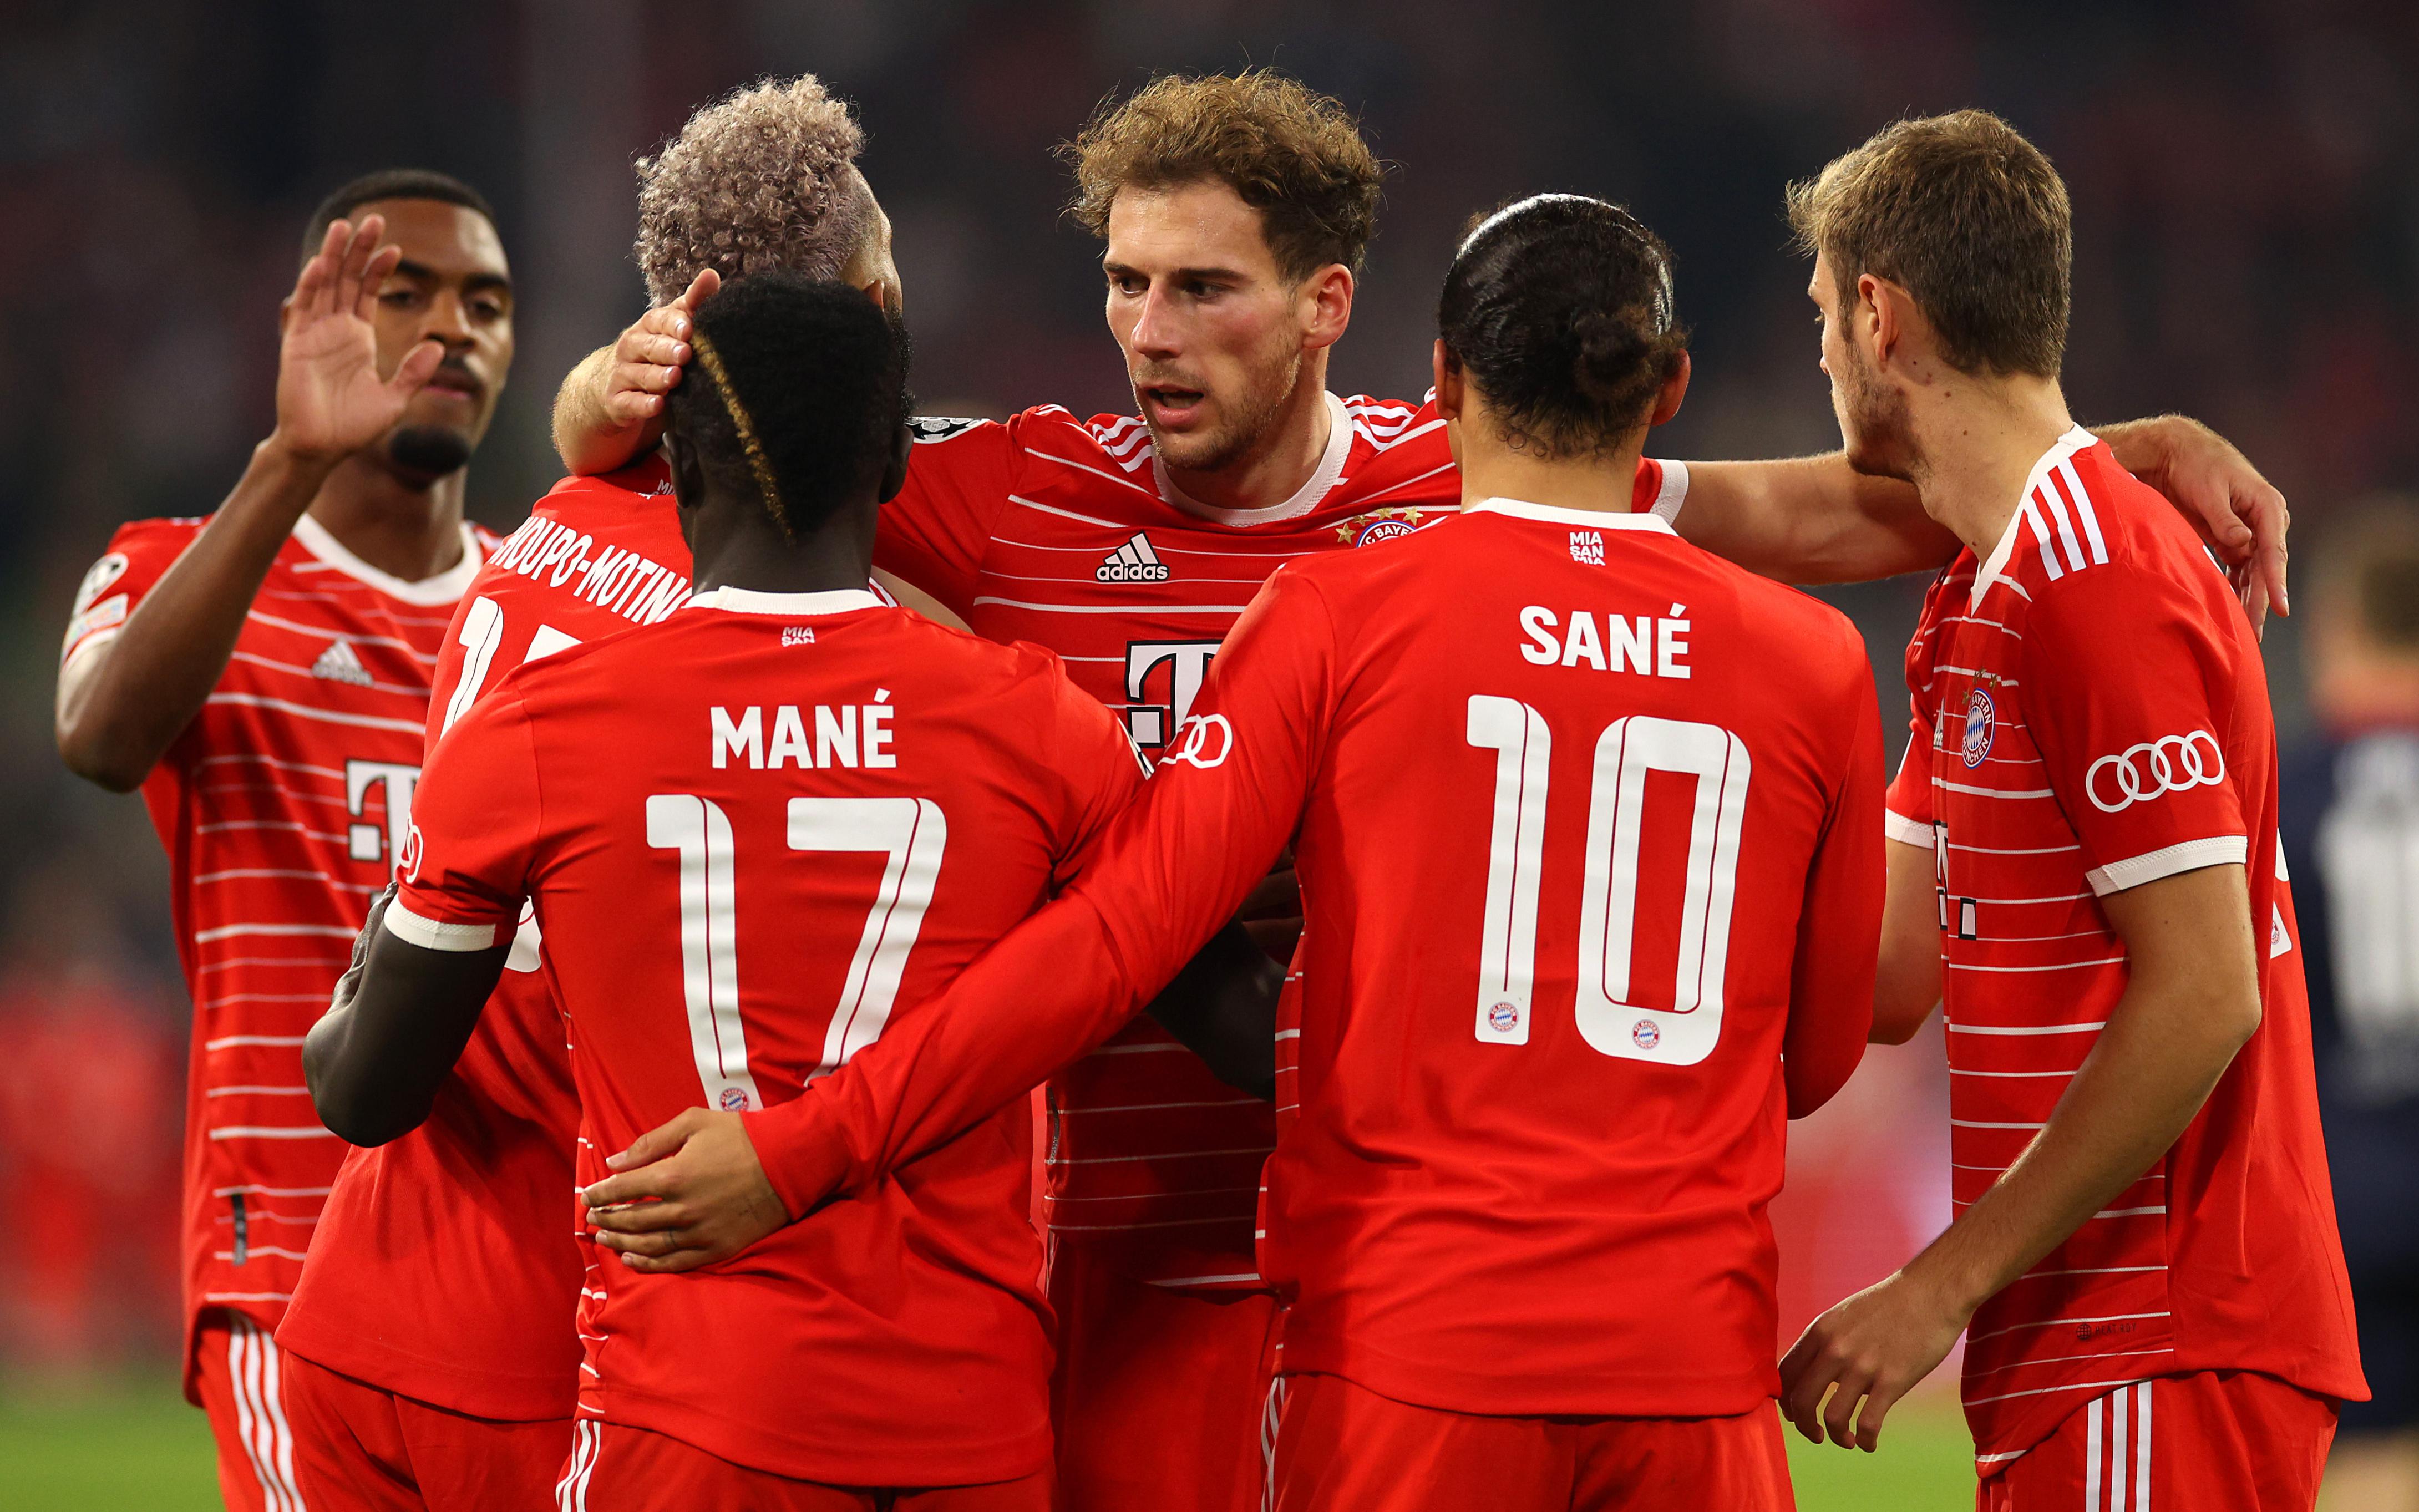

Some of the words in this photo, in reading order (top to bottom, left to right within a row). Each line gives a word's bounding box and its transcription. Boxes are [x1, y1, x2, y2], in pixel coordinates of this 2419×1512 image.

[657, 479, 675, 495] MI
[1569, 531, 1603, 545] MIA
[1569, 546, 1604, 557] SAN
[1573, 555, 1606, 566] MIA
[1097, 562, 1168, 580] adidas
[782, 627, 814, 637] MIA
[1520, 602, 1691, 679] SANÉ
[782, 636, 815, 647] SAN
[440, 595, 584, 740] 1
[711, 688, 896, 769] MANÉ
[1467, 694, 1751, 1065] 10
[646, 794, 947, 1111] 17
